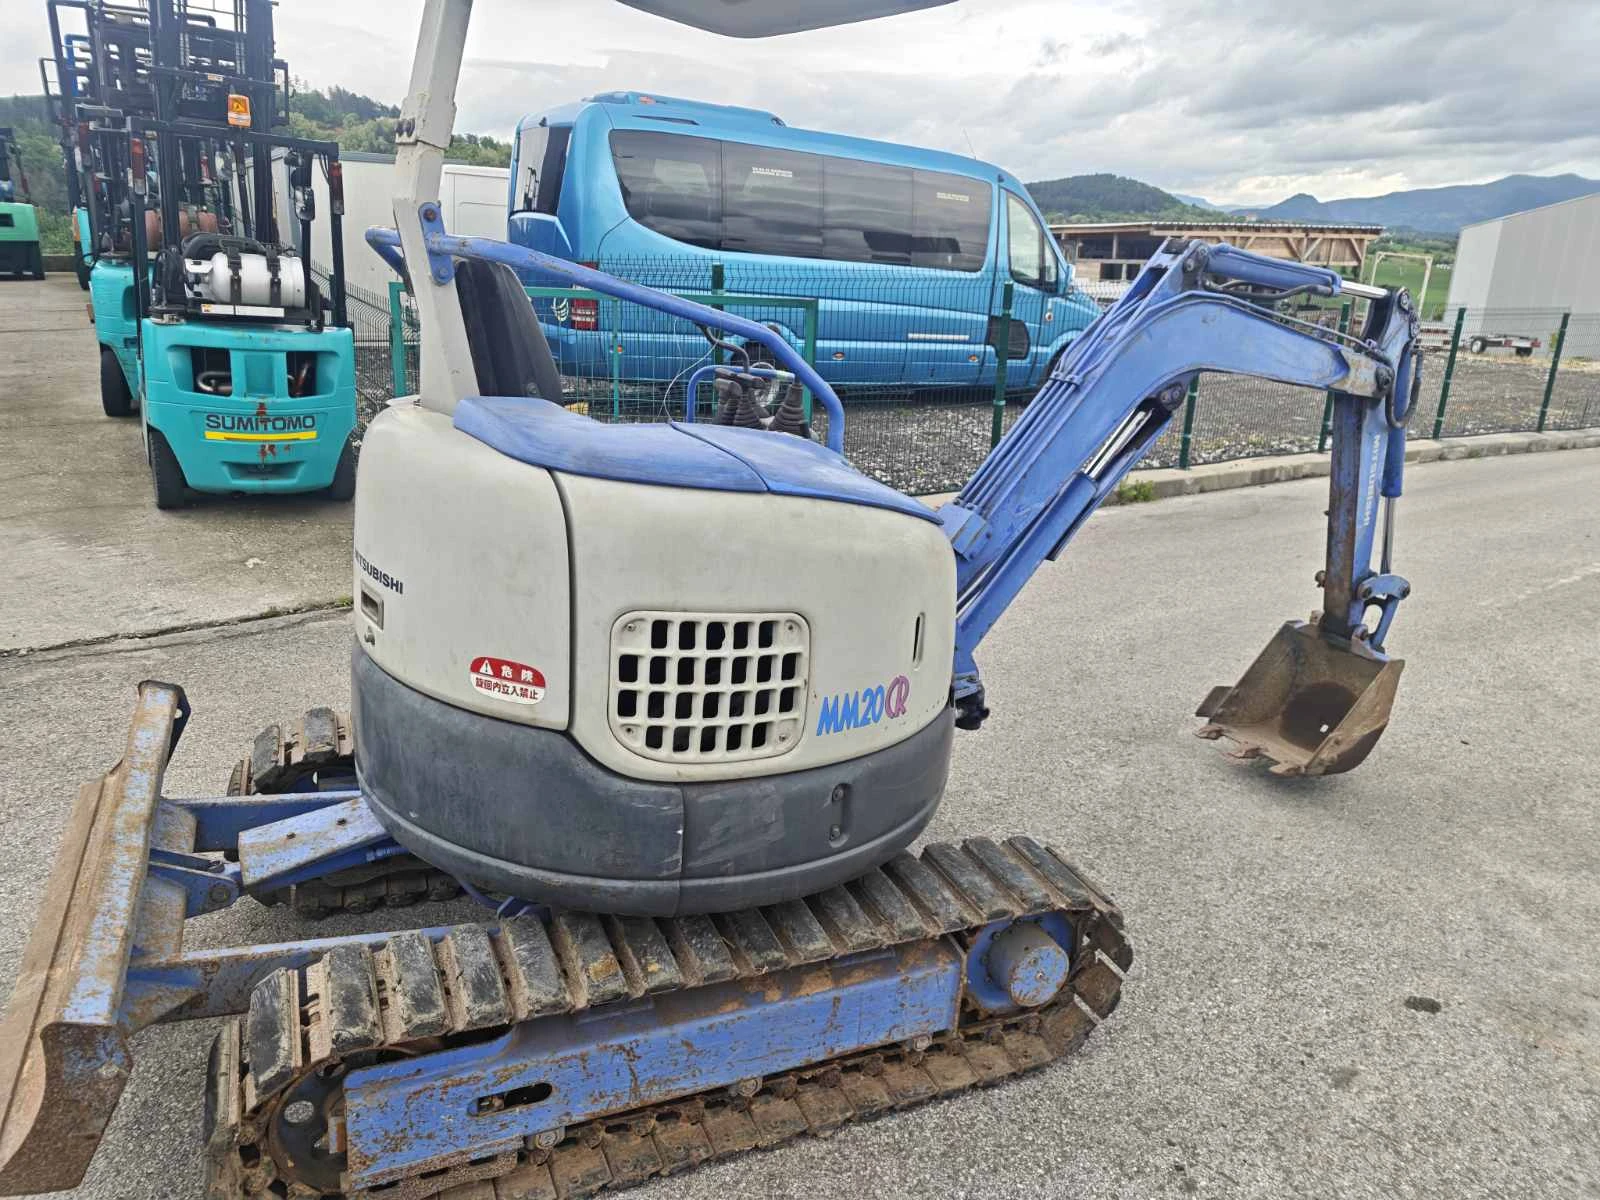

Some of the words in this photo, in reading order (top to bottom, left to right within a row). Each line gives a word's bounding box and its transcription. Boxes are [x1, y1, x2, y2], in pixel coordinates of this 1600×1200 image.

[206, 414, 316, 431] SUMITOMO
[355, 549, 404, 595] ITSUBISHI
[501, 664, 533, 682] 危険
[475, 677, 539, 700] 旋回内立入禁止
